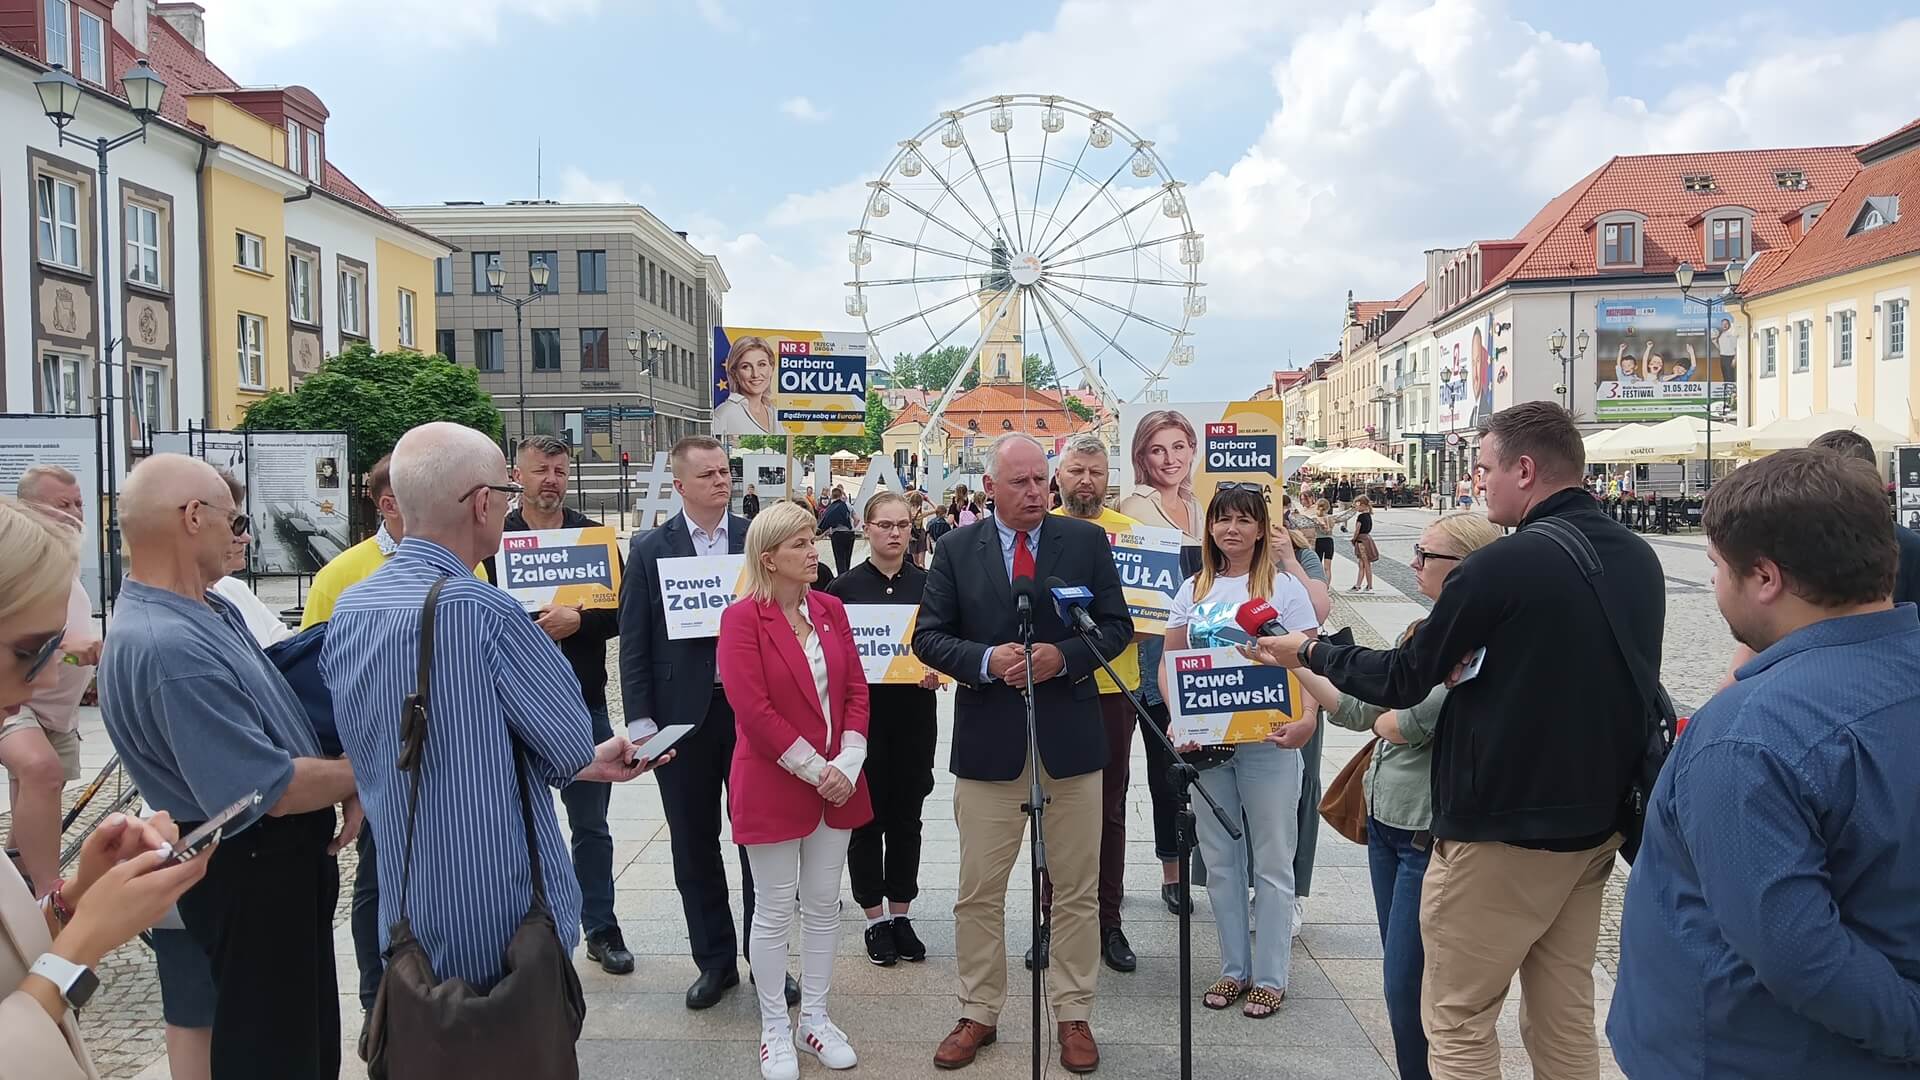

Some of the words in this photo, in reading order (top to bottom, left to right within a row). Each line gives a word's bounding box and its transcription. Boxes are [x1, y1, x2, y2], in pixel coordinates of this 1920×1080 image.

[781, 343, 798, 353] NR
[799, 343, 806, 352] 3
[781, 357, 834, 370] Barbara
[780, 371, 864, 392] OKUŁA
[1622, 390, 1655, 398] FESTIWAL
[1663, 384, 1702, 393] 31.05.2024
[783, 411, 812, 421] Bądźmy
[812, 413, 829, 421] sobą
[1211, 425, 1226, 434] NR
[1227, 425, 1234, 434] 3
[1209, 440, 1257, 450] Barbara
[1209, 451, 1271, 468] Okuła
[509, 539, 525, 548] NR
[528, 538, 533, 547] 1
[510, 549, 568, 566] Paweł
[511, 561, 606, 583] Zalewski
[1116, 563, 1174, 590] UŁA
[665, 576, 721, 591] Paweł
[851, 625, 890, 637] aweł
[856, 640, 911, 657] alew
[1182, 659, 1199, 669] NR
[1201, 658, 1206, 668] 1
[1182, 670, 1244, 690] Paweł
[1184, 684, 1285, 709] Zalewski
